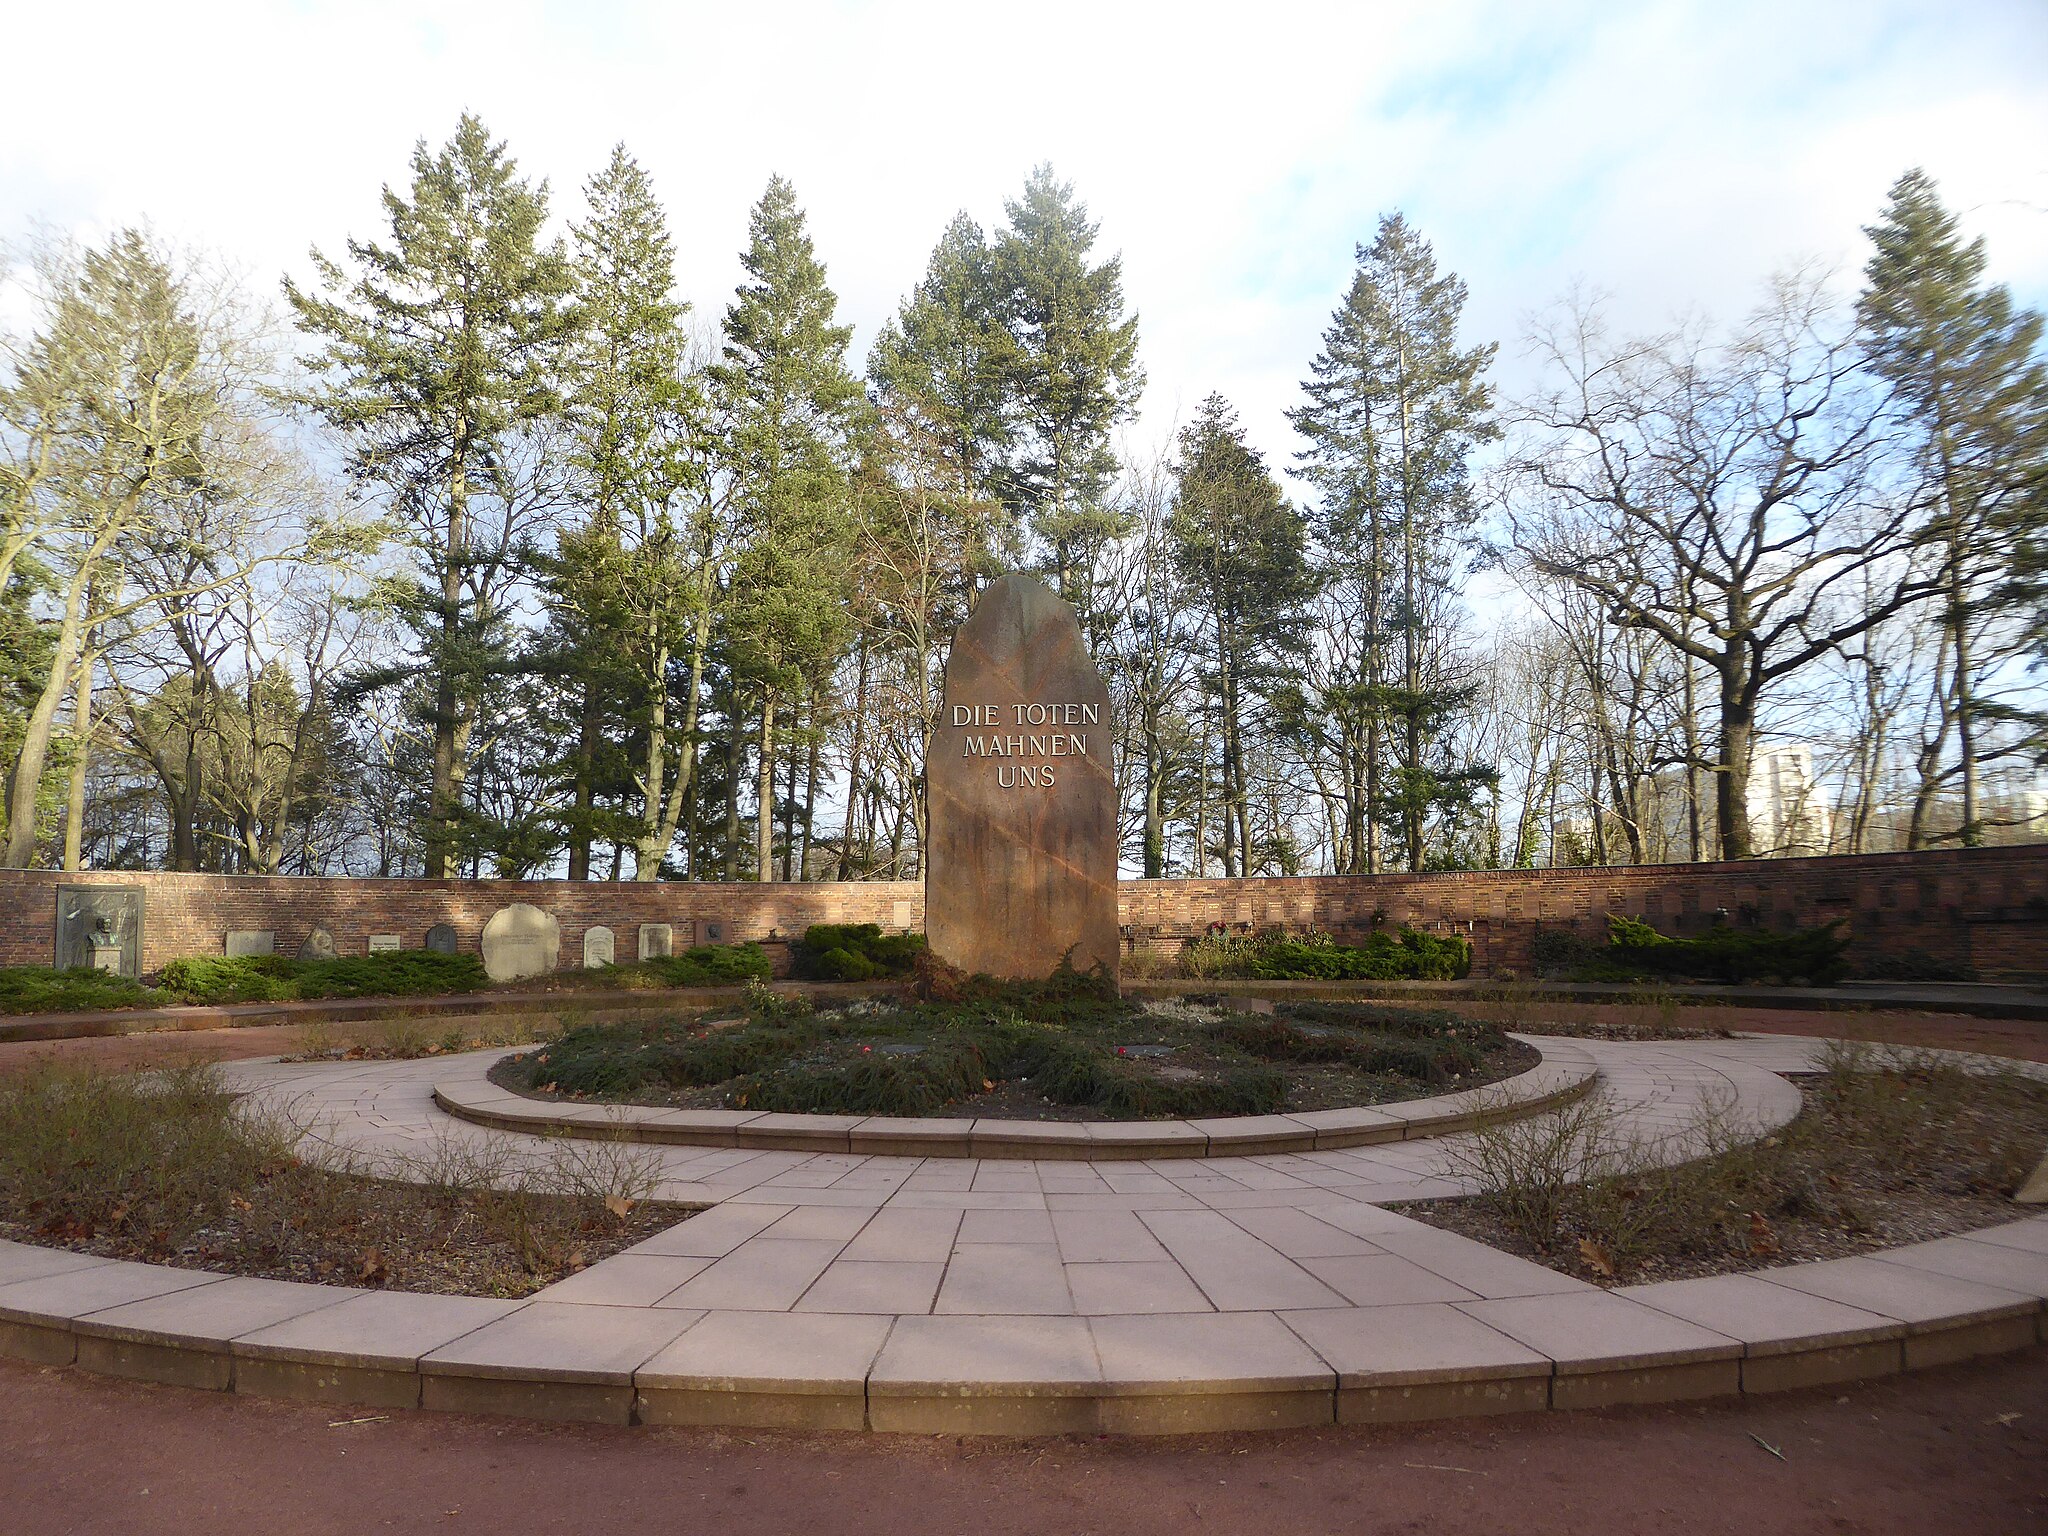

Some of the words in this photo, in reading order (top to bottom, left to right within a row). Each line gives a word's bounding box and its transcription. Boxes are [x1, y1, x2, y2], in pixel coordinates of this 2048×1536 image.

[952, 705, 1000, 726] DIE
[1012, 703, 1099, 725] TOTEN
[963, 734, 1088, 757] MAHNEN
[997, 765, 1055, 788] UNS
